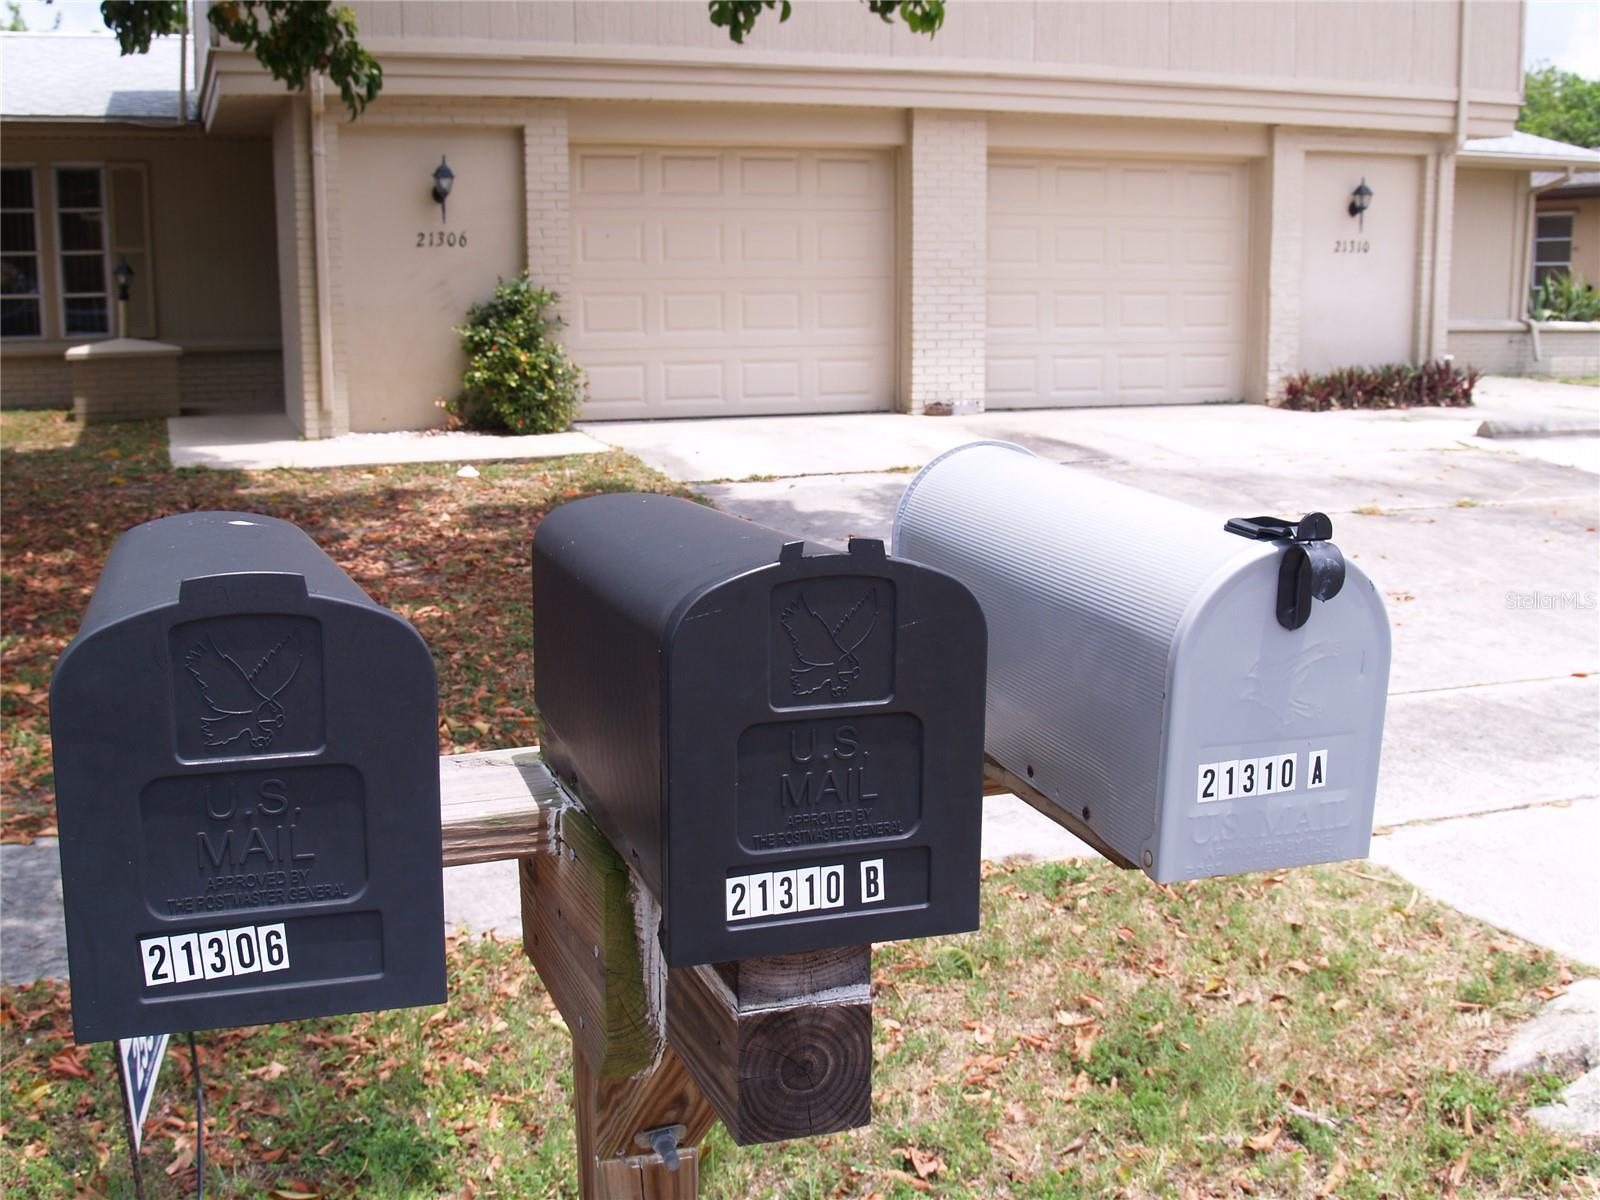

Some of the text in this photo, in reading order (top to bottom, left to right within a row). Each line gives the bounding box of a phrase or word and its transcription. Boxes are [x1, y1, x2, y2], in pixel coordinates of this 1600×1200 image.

[416, 231, 467, 248] 21306
[1333, 240, 1370, 254] 21310
[791, 725, 871, 764] U.S.
[780, 767, 878, 808] MAIL
[1202, 755, 1323, 799] 21310 A
[205, 778, 301, 820] U.S.
[787, 807, 873, 826] APPROVED BY
[197, 824, 316, 868] MAIL
[752, 819, 904, 850] THE POSTMASTER GENERAL
[167, 882, 350, 915] THE POSTMASTER GENERAL
[206, 868, 310, 891] APPROVED BY
[731, 865, 880, 917] 21310 B
[148, 929, 285, 981] 21306
